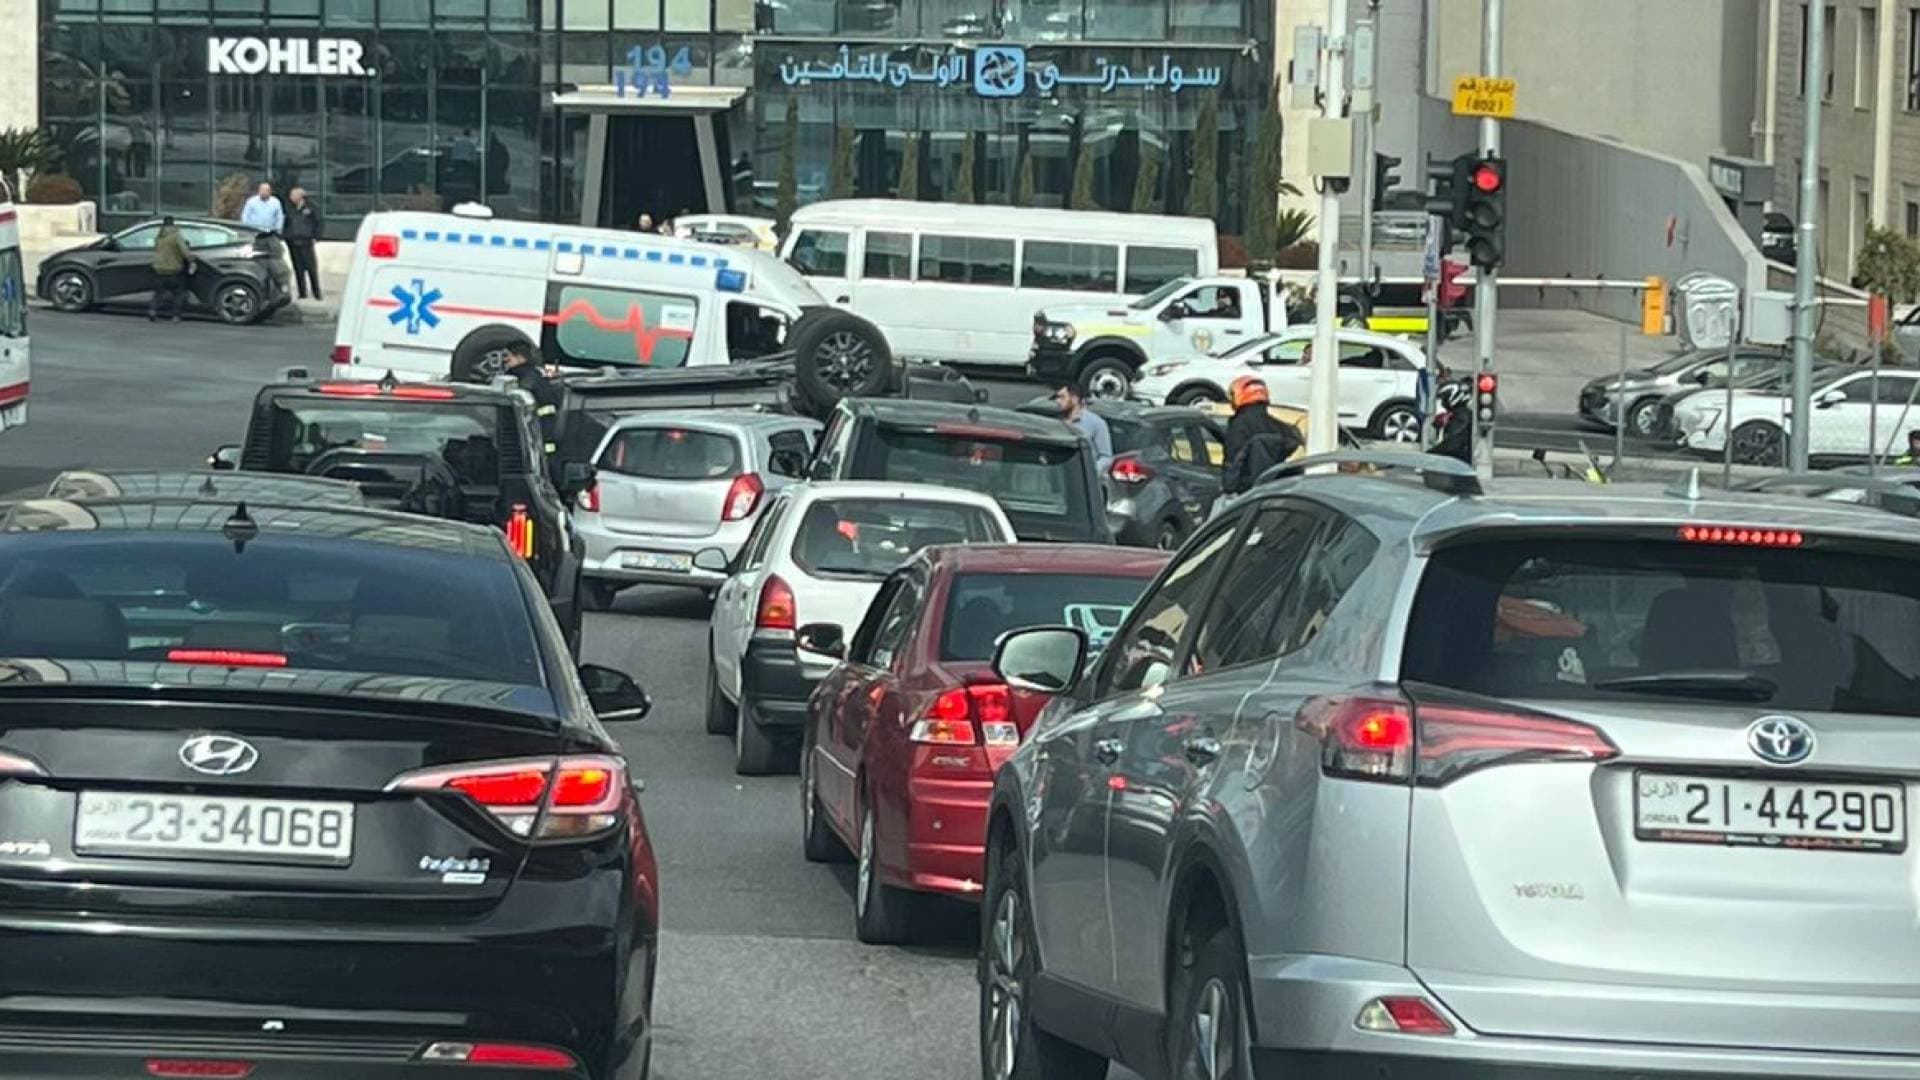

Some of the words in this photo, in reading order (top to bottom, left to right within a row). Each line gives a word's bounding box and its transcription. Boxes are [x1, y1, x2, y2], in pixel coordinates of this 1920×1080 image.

[780, 44, 889, 85] للتأمين
[890, 47, 968, 88] الأولى
[1034, 54, 1221, 97] سوليدرتي
